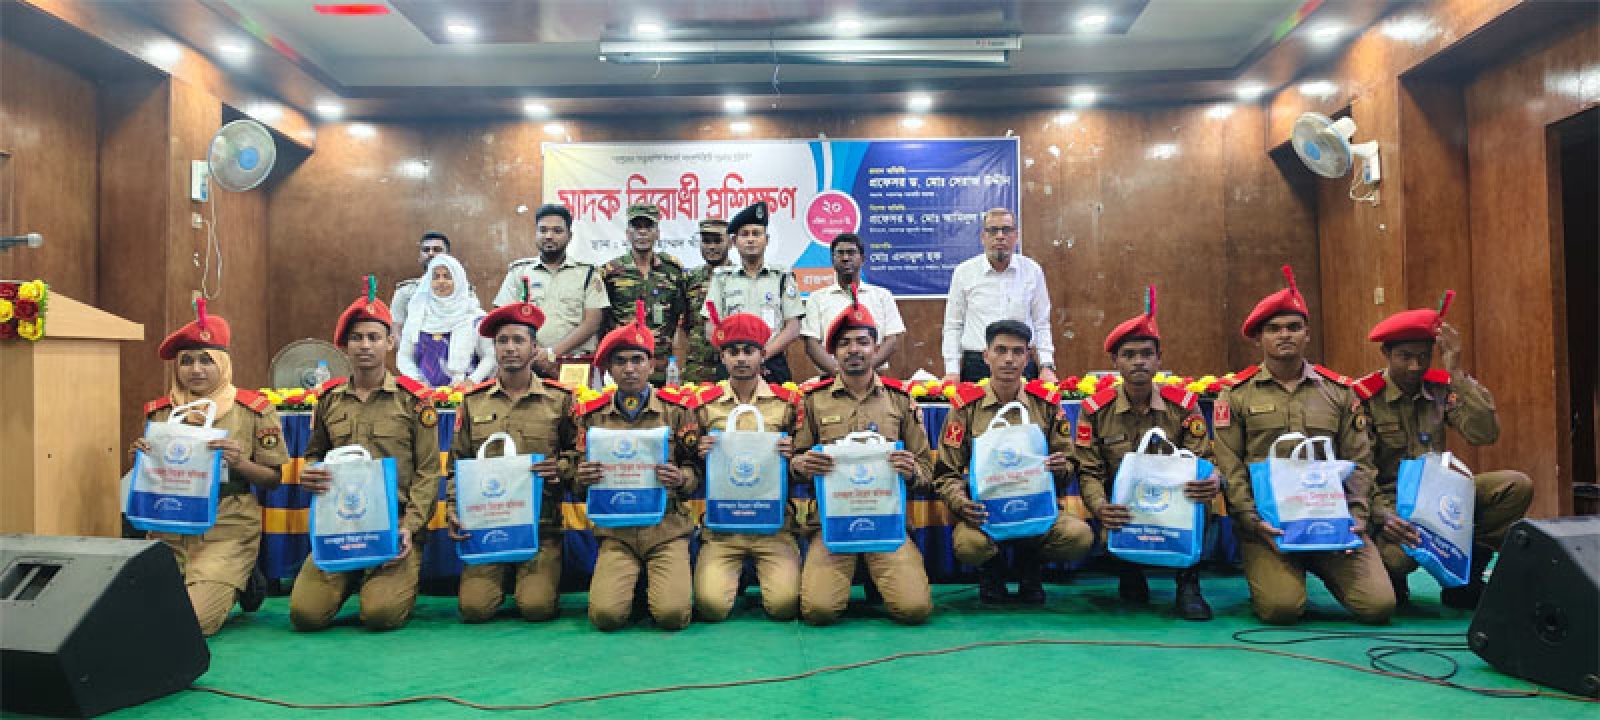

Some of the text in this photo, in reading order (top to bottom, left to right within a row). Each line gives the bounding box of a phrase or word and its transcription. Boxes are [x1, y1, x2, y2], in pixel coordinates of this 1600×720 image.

[869, 177, 906, 189] প্রফেসর
[557, 172, 798, 222] মাদক বিরোধী প্রশিক্ষণ
[821, 200, 843, 214] ২০
